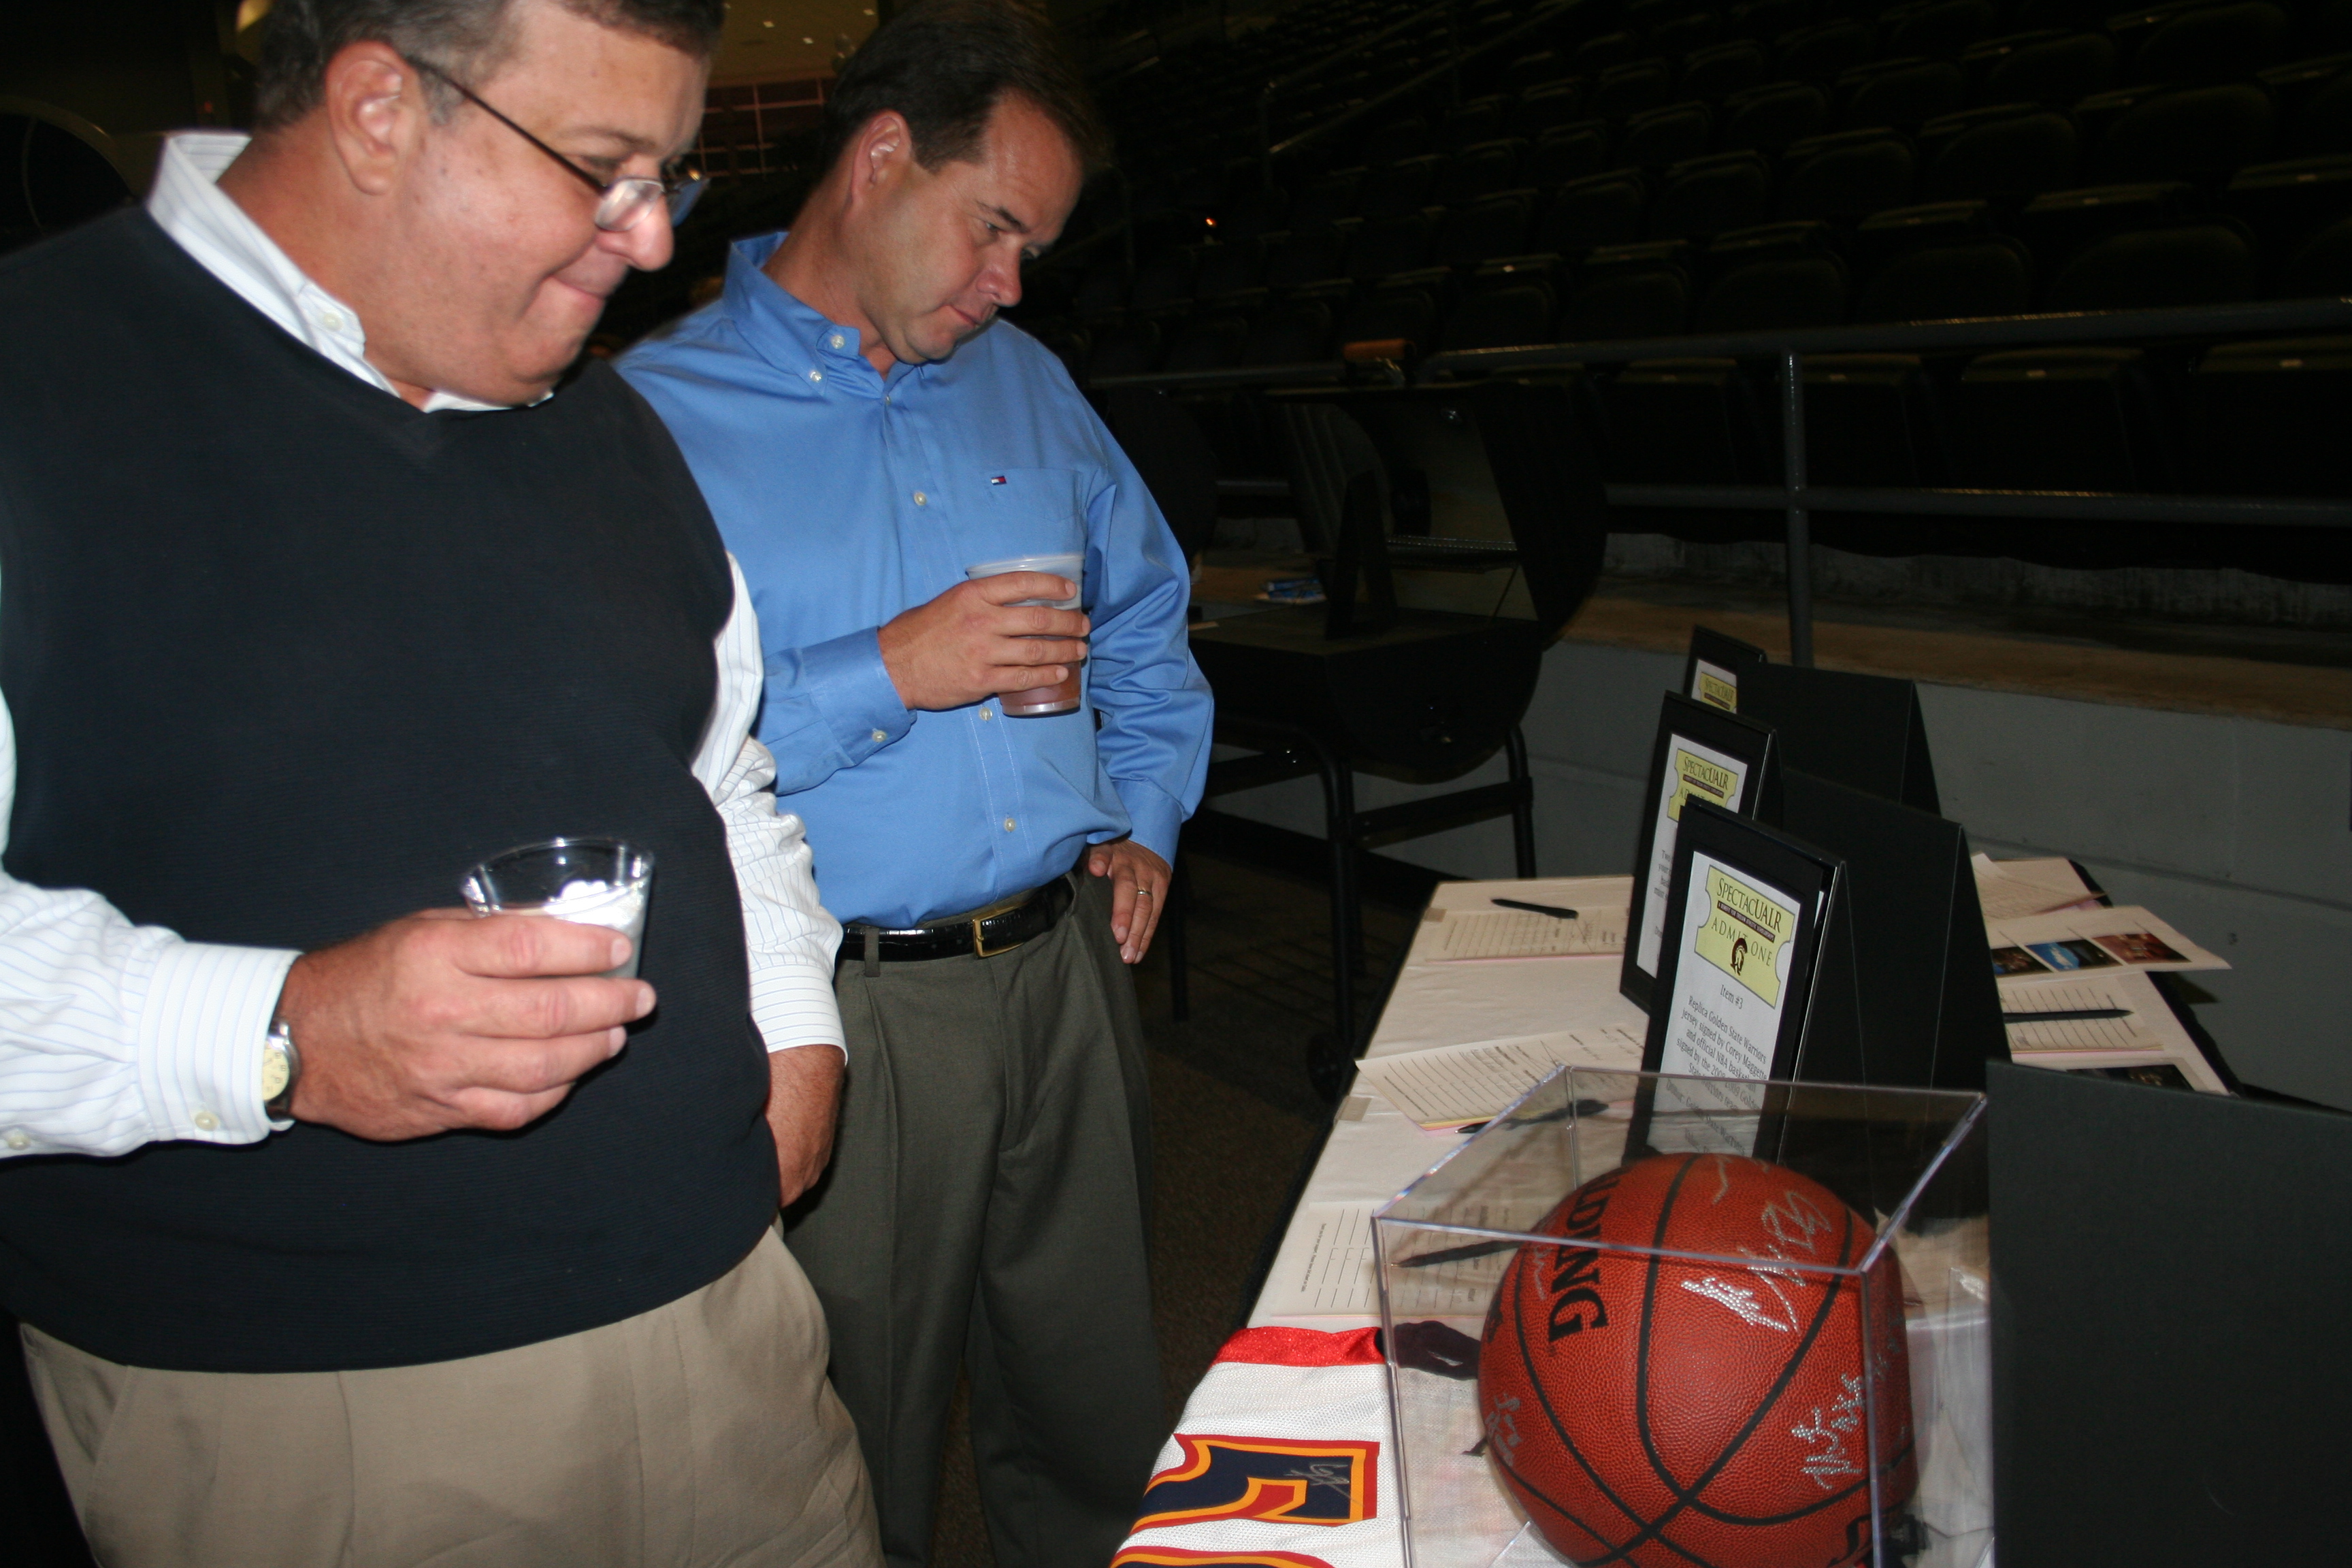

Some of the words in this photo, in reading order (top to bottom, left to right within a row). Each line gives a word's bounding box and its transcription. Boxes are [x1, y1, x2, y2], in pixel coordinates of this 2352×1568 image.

[1683, 757, 1729, 789] SPECTACUALR
[1717, 878, 1781, 933] SPECTACUALR
[1750, 941, 1772, 966] ONE
[1720, 984, 1734, 1003] Item
[1735, 996, 1744, 1009] #3
[1681, 1008, 1699, 1029] jersey
[1699, 1022, 1716, 1041] signed
[1716, 1034, 1725, 1049] by
[1725, 1041, 1742, 1063] Corey
[1742, 1054, 1767, 1080] Maggette
[1688, 995, 1708, 1017] Replica
[1708, 1011, 1728, 1034] Golden
[1729, 1026, 1743, 1045] State
[1744, 1036, 1767, 1064] Warriors
[1676, 1038, 1693, 1058] signed
[1693, 1048, 1701, 1063] by
[1701, 1057, 1711, 1072] the
[1686, 1028, 1697, 1043] and
[1696, 1036, 1716, 1058] official
[1716, 1051, 1728, 1069] NBA
